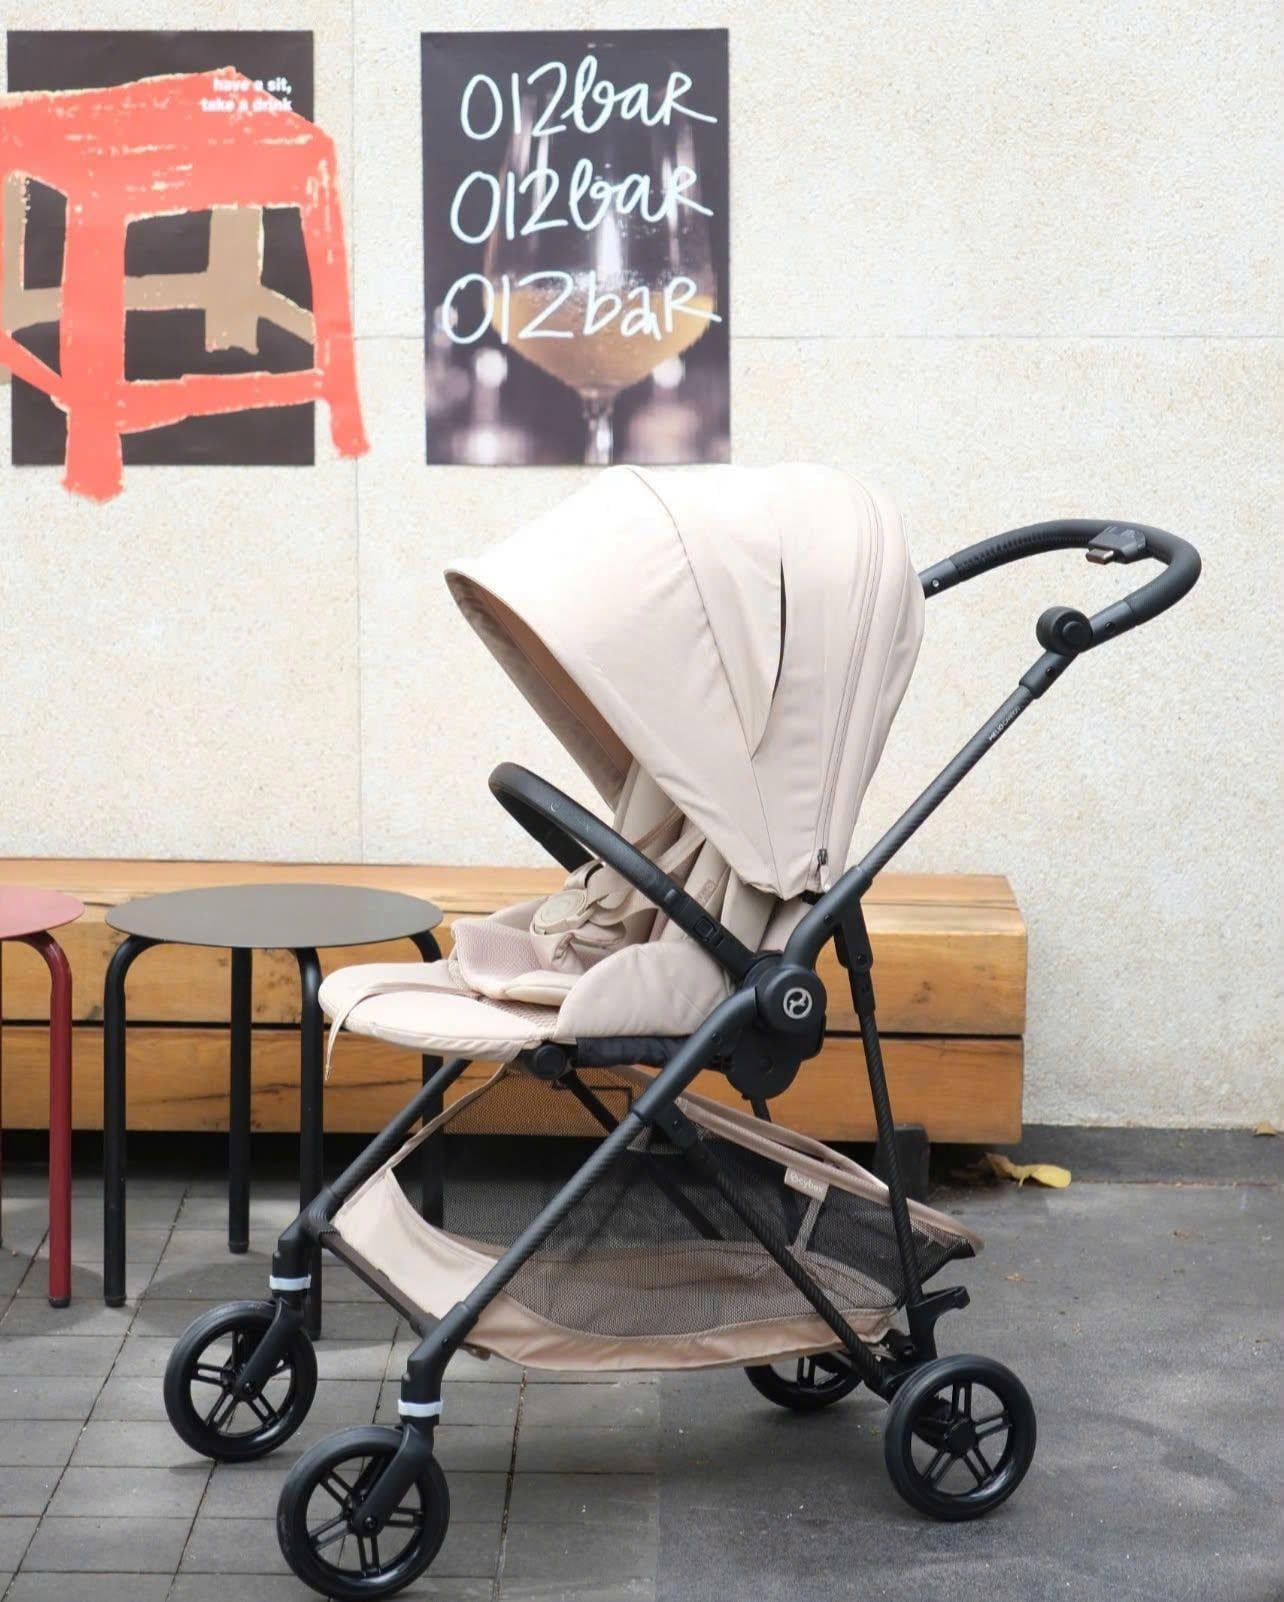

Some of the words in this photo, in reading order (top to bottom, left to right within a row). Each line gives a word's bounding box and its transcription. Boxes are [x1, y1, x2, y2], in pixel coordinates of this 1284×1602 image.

[213, 78, 250, 92] have
[254, 80, 264, 92] a
[267, 77, 292, 95] sit,
[200, 97, 235, 112] take
[239, 100, 249, 112] a
[252, 97, 293, 112] drink
